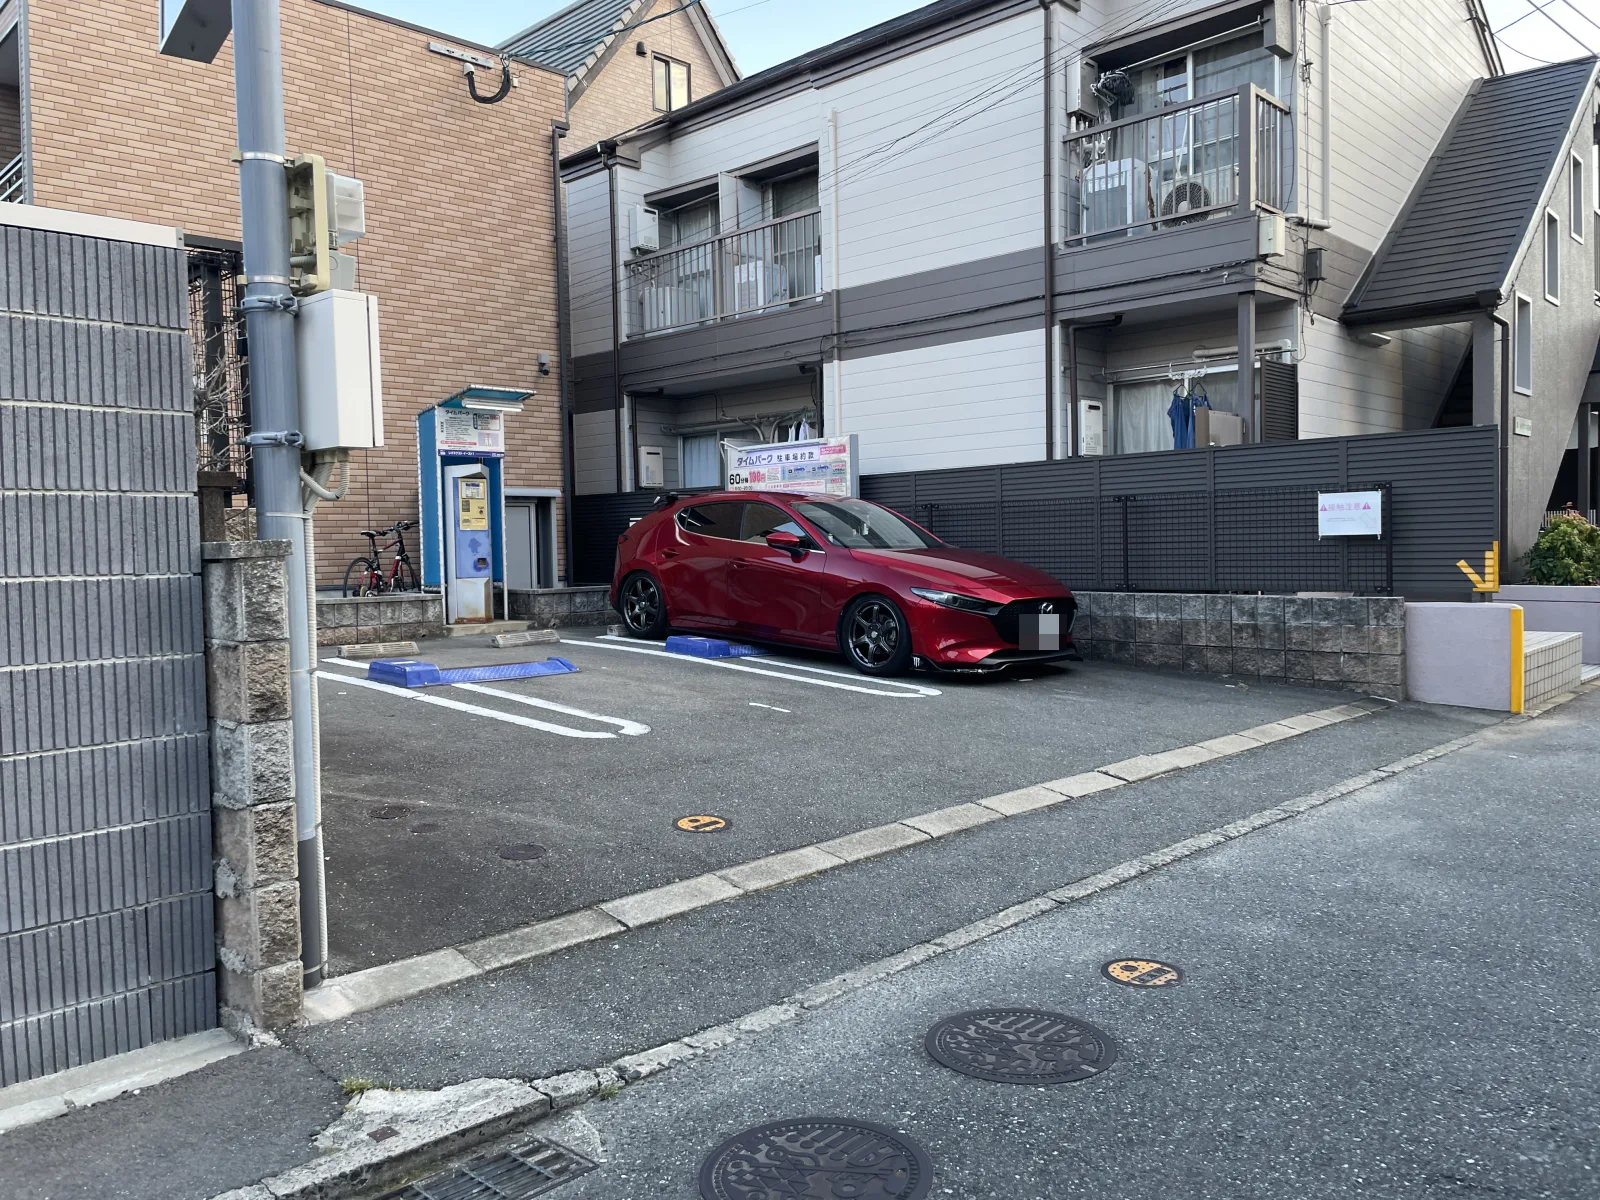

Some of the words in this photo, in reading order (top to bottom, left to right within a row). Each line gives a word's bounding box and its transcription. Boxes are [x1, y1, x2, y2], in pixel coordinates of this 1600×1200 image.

[737, 454, 772, 466] タイムパーク
[777, 452, 815, 462] 駐車場約款
[749, 470, 766, 484] 100円
[1328, 502, 1361, 511] 接触注意
